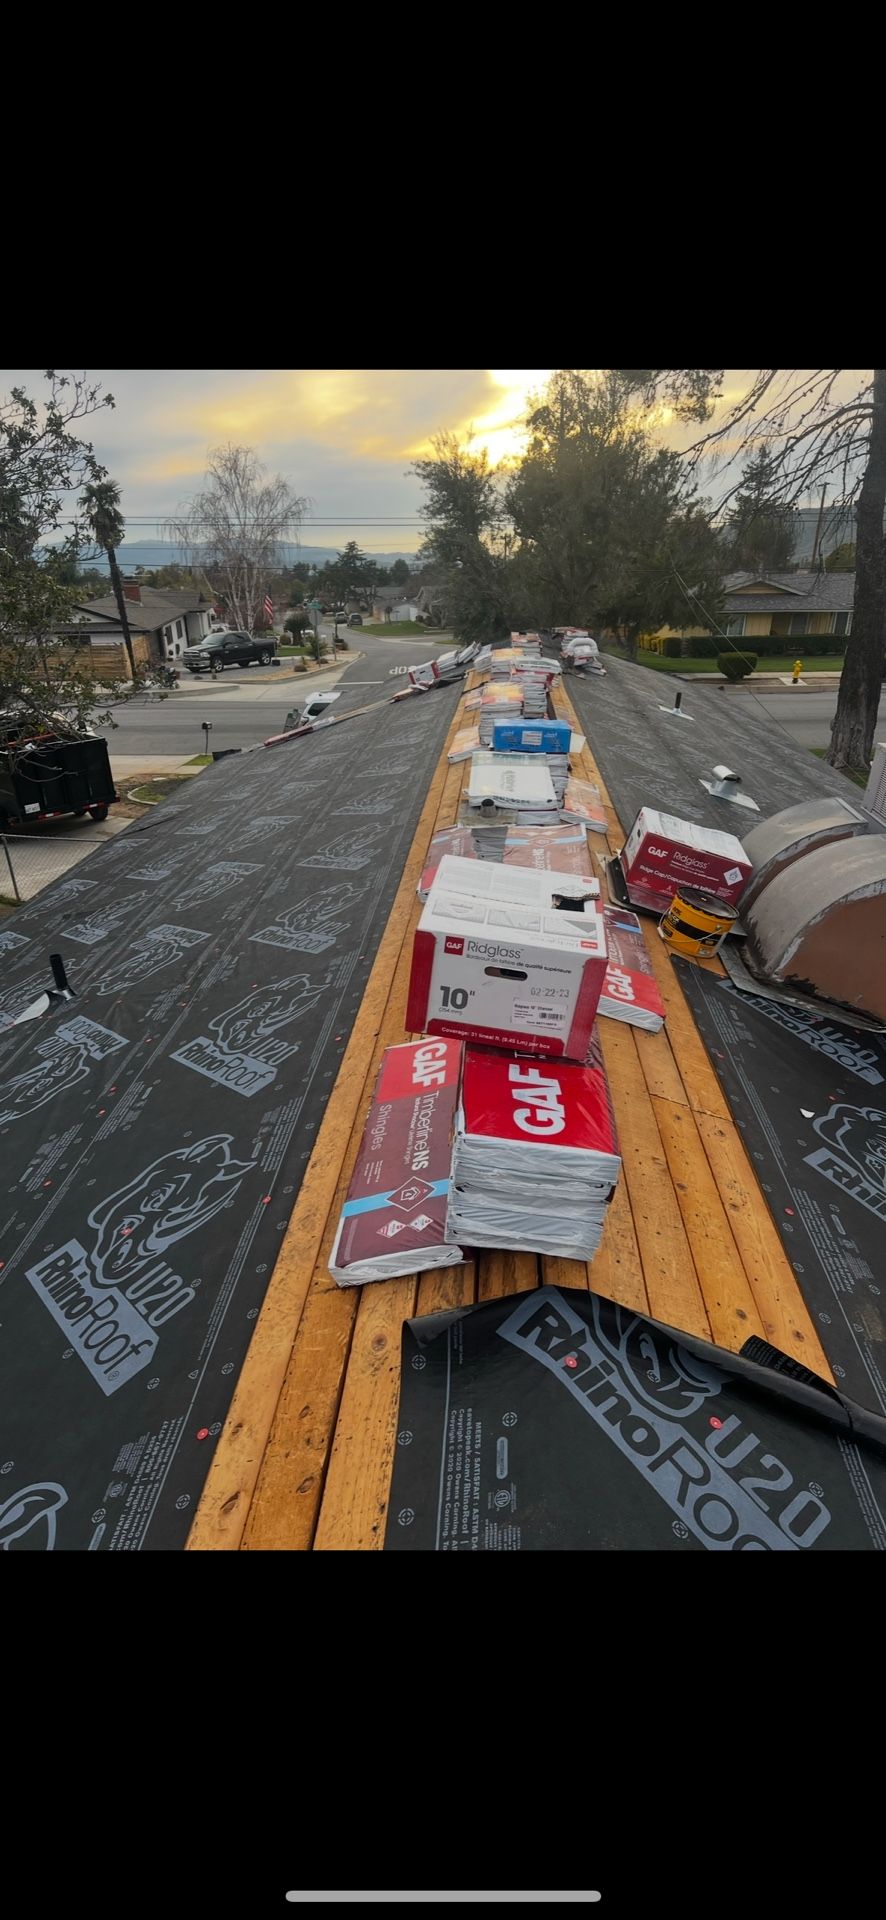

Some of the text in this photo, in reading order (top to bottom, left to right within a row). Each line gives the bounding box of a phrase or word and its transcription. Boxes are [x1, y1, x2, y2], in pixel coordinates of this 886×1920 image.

[648, 847, 709, 869] GAF Ridglass
[446, 941, 463, 949] GAF
[467, 940, 522, 959] Ridglass
[606, 964, 635, 1000] GAF
[441, 1027, 470, 1037] Coverage:
[819, 1027, 879, 1065] U20
[177, 1042, 275, 1090] RhinoRoof
[248, 1037, 300, 1066] U20
[412, 1042, 448, 1087] GAF
[508, 1063, 566, 1136] GAF
[371, 1104, 392, 1151] Shingles
[126, 1261, 196, 1328] U20
[35, 1251, 154, 1375] RhinoRoof
[449, 1410, 457, 1443] Copyright
[457, 1408, 465, 1442] Copyright
[445, 1474, 453, 1501] Owens
[454, 1473, 462, 1500] Owens
[704, 1414, 832, 1548] U20
[451, 1502, 460, 1538] Corning.
